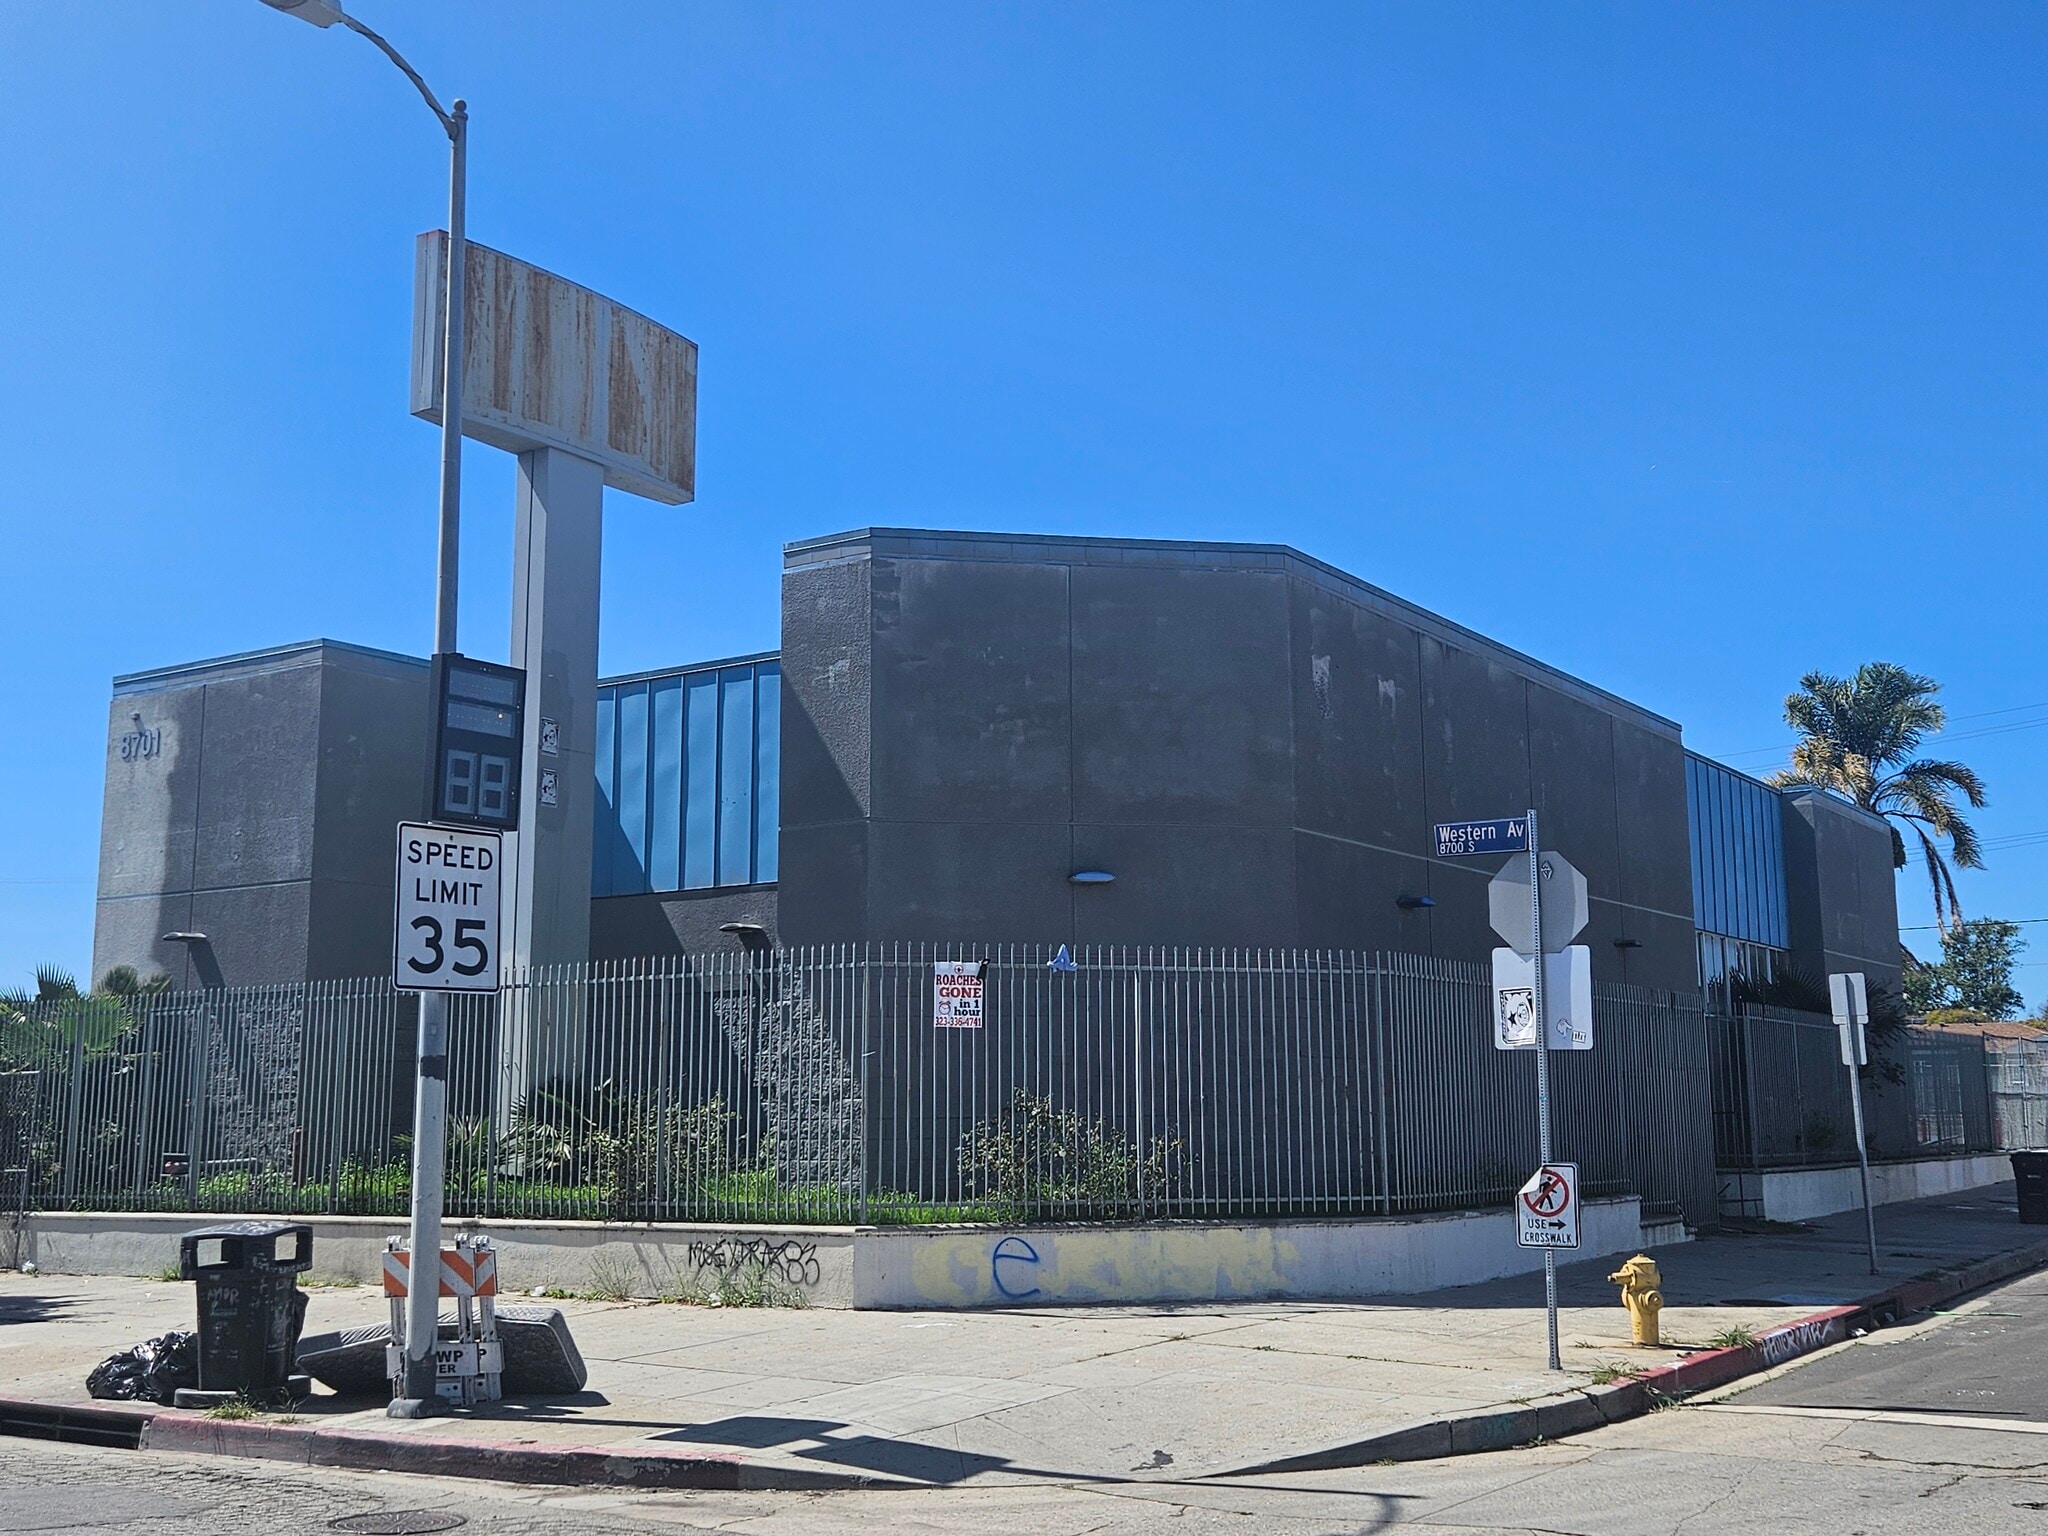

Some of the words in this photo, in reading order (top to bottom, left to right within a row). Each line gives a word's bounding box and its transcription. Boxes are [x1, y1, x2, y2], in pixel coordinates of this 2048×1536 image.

[122, 729, 161, 760] 8701
[1439, 825, 1496, 842] Western
[1507, 821, 1524, 839] Av
[1439, 842, 1464, 855] 8700
[1468, 841, 1475, 853] S
[407, 840, 493, 871] SPEED
[415, 877, 483, 906] LIMIT
[407, 915, 489, 976] 35
[936, 974, 982, 987] ROACHES
[939, 986, 982, 999] GONE
[959, 998, 971, 1008] in
[974, 999, 980, 1009] 1
[954, 1006, 981, 1016] hour
[1527, 1218, 1547, 1229] USE
[1524, 1231, 1572, 1244] CROSSWALK
